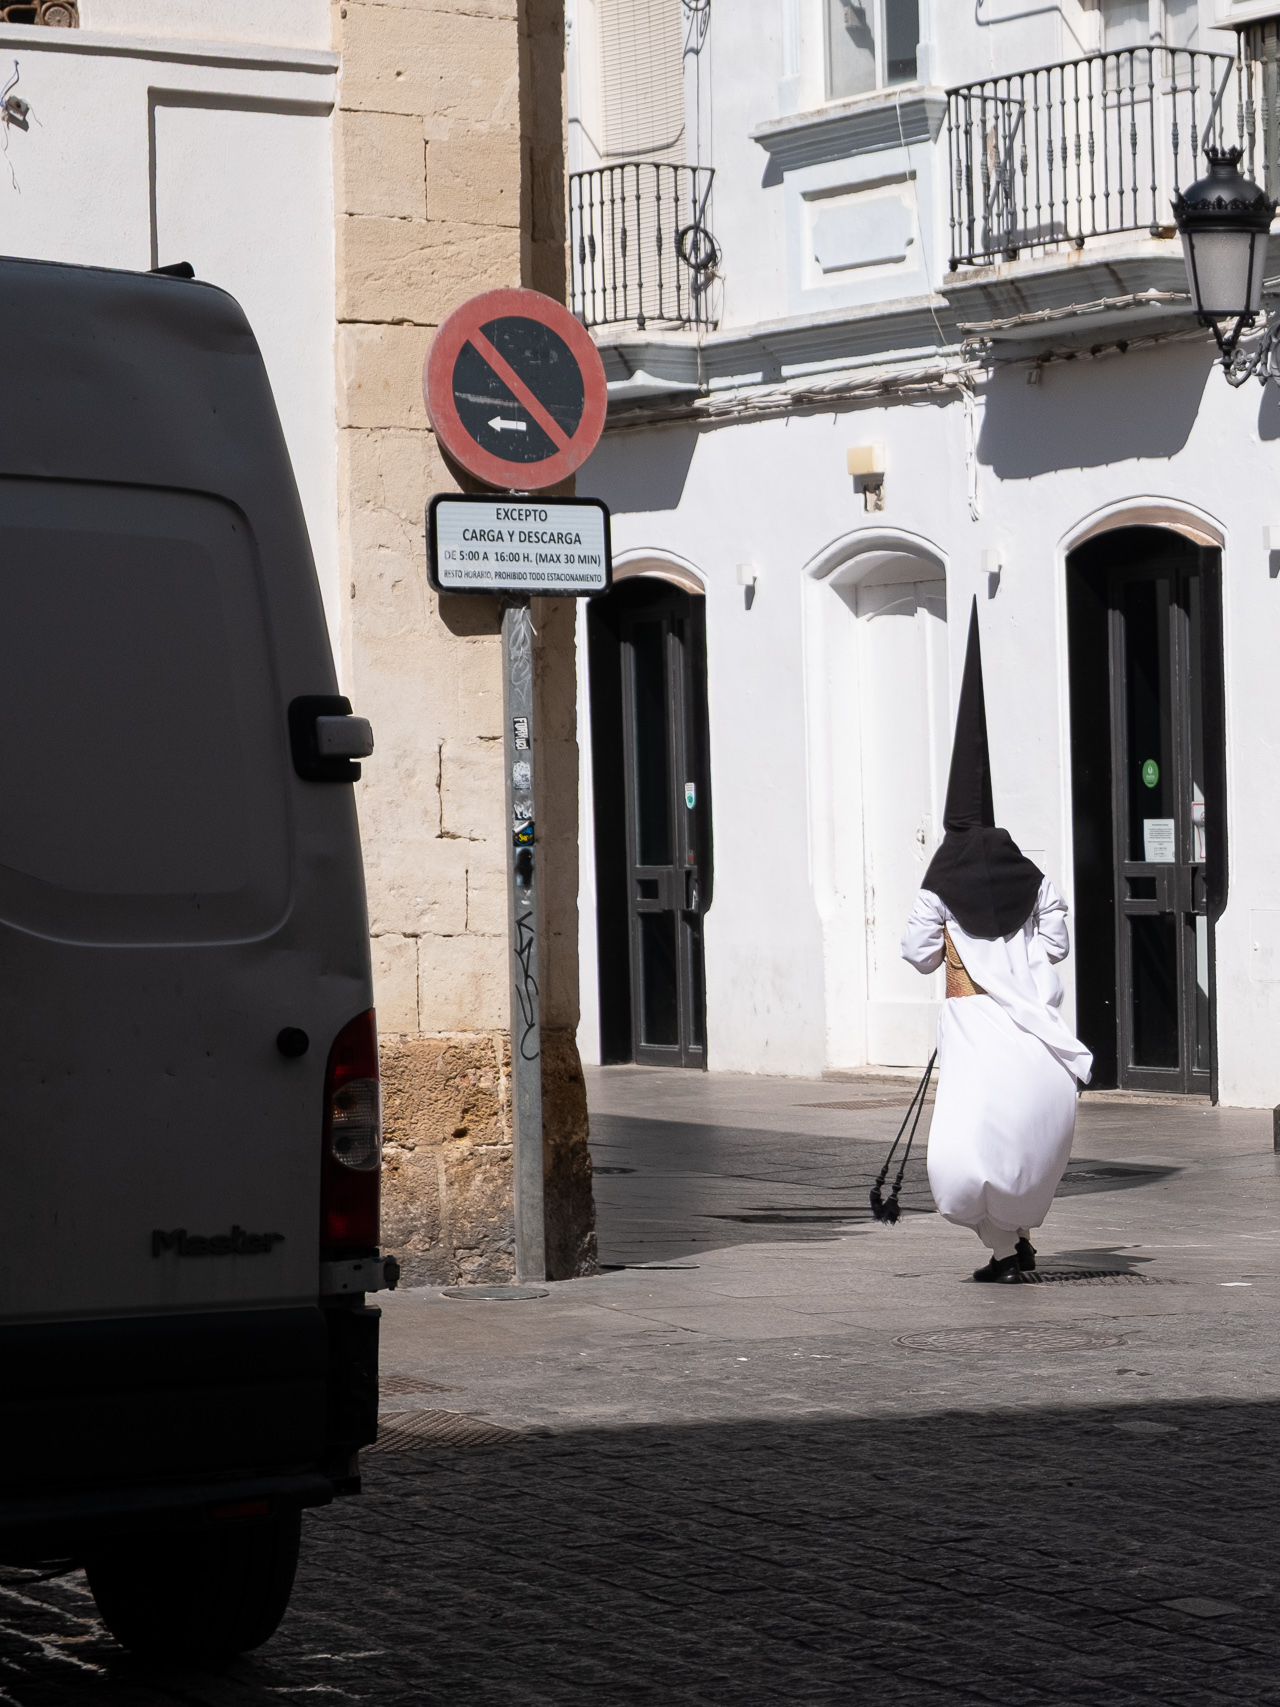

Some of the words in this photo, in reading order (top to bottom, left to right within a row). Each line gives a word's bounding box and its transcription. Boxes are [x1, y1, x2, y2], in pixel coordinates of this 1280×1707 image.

[496, 507, 548, 522] EXCEPTO
[462, 528, 505, 542] CARGA
[507, 530, 515, 543] Y
[518, 531, 582, 545] DESCARGA
[444, 550, 456, 560] DE
[459, 550, 480, 561] 5:00
[482, 551, 489, 561] A
[494, 551, 520, 563] 16:00
[522, 553, 533, 563] H.
[535, 553, 562, 565] (MAX
[564, 554, 575, 564] 30
[577, 554, 601, 567] MIN)
[444, 569, 462, 578] RESTO
[464, 570, 494, 580] HORARIO,
[494, 571, 527, 581] PROHIBIDO
[529, 572, 546, 581] TODO
[547, 572, 602, 583] ESTACIONAMIENTO
[152, 1224, 286, 1258] Master
